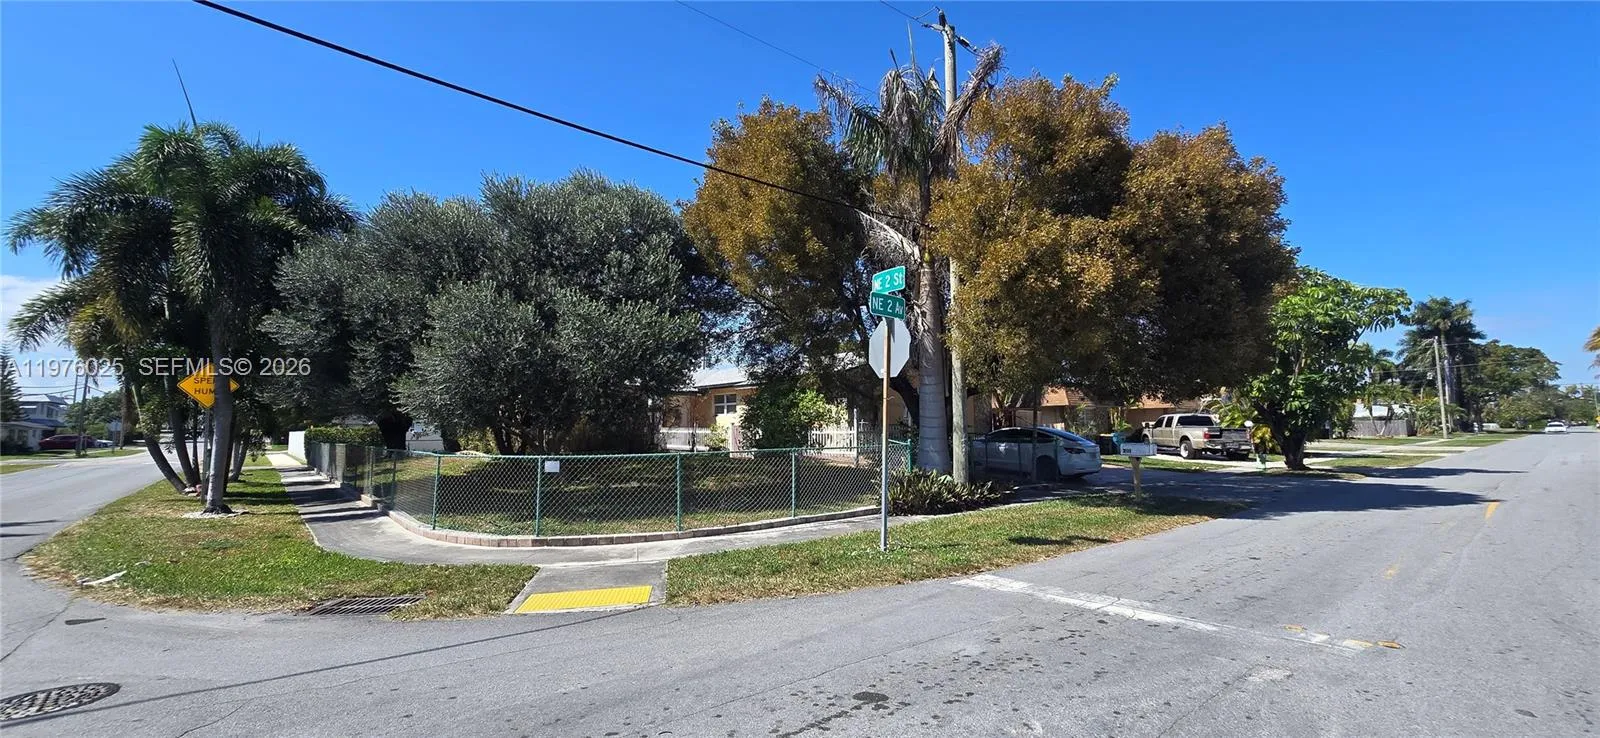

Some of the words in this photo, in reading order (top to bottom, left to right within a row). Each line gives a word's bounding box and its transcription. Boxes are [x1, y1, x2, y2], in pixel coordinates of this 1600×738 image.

[885, 275, 891, 288] 2
[893, 271, 903, 286] St
[872, 296, 884, 311] NE
[887, 299, 893, 313] 2
[193, 377, 216, 385] SPE
[194, 387, 216, 395] HUM
